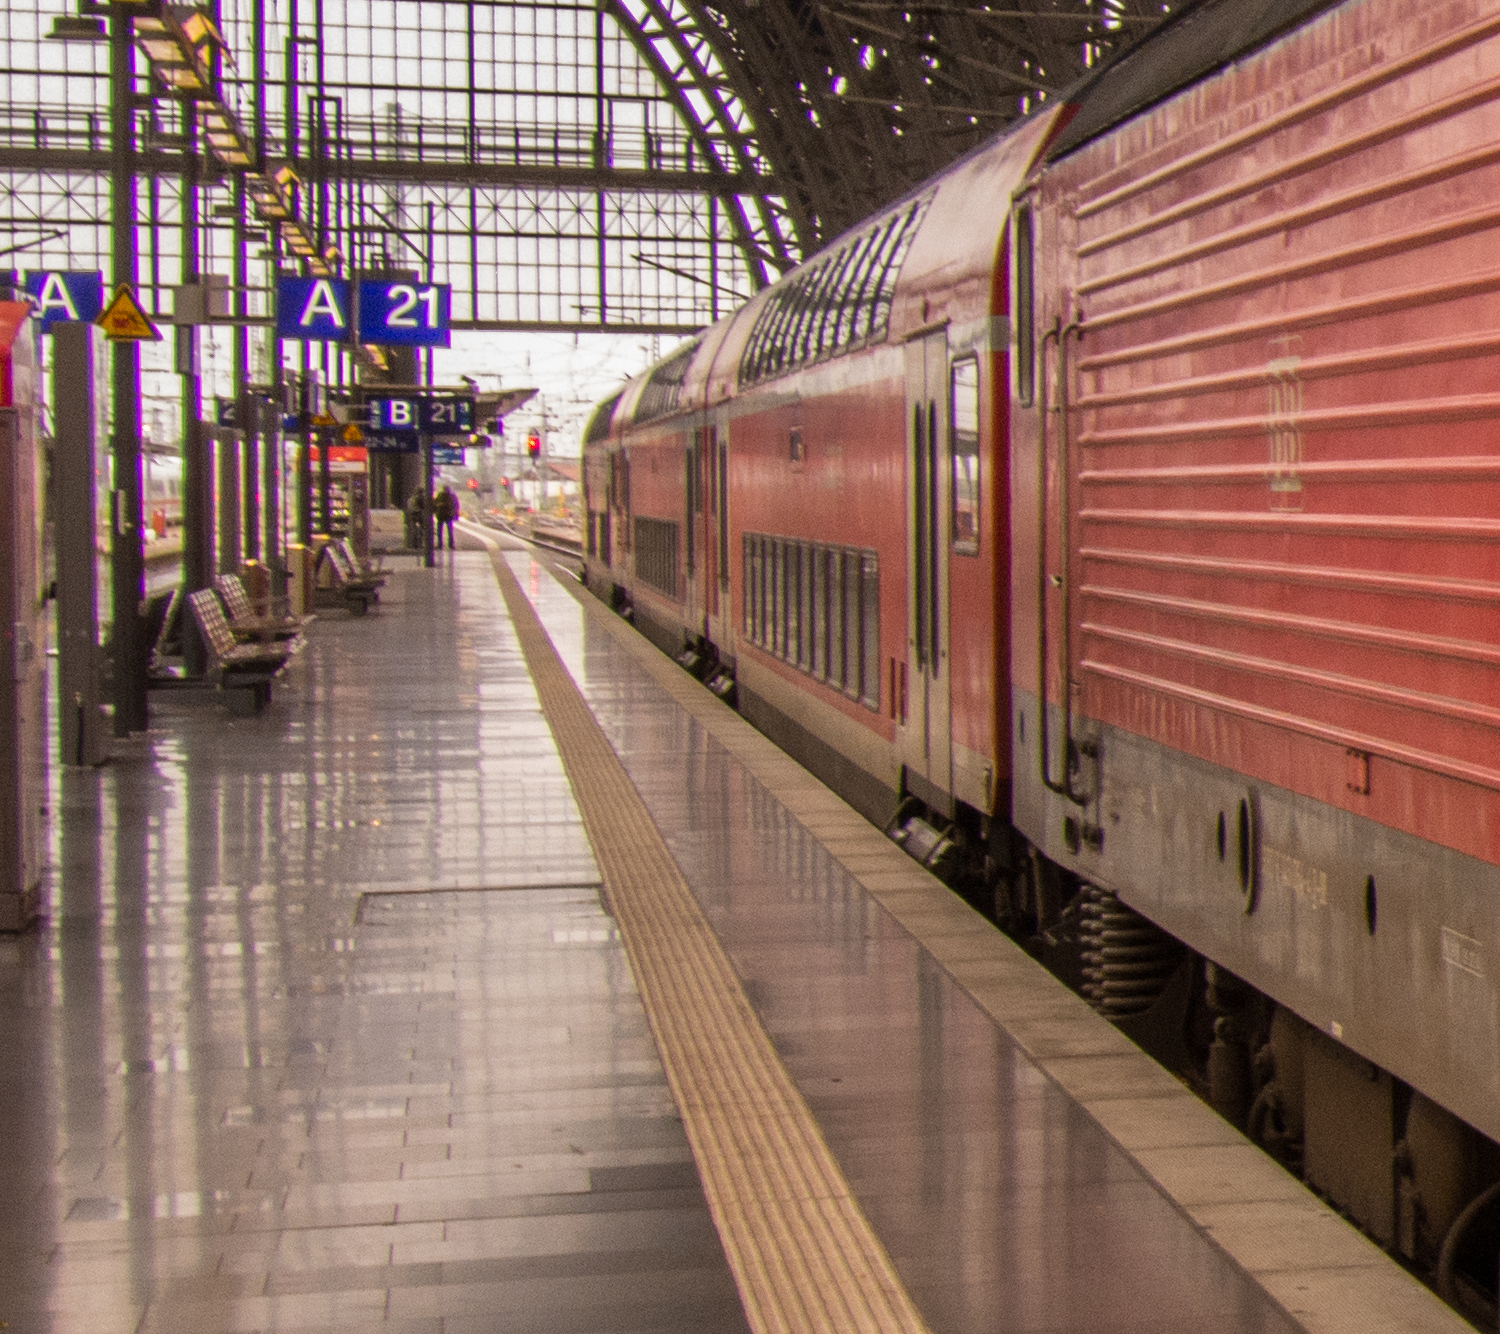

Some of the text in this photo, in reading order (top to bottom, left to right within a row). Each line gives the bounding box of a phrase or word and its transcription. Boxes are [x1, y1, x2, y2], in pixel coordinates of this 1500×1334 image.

[38, 271, 80, 321] A
[300, 279, 439, 328] A 21
[389, 400, 411, 425] B
[430, 402, 456, 423] 21
